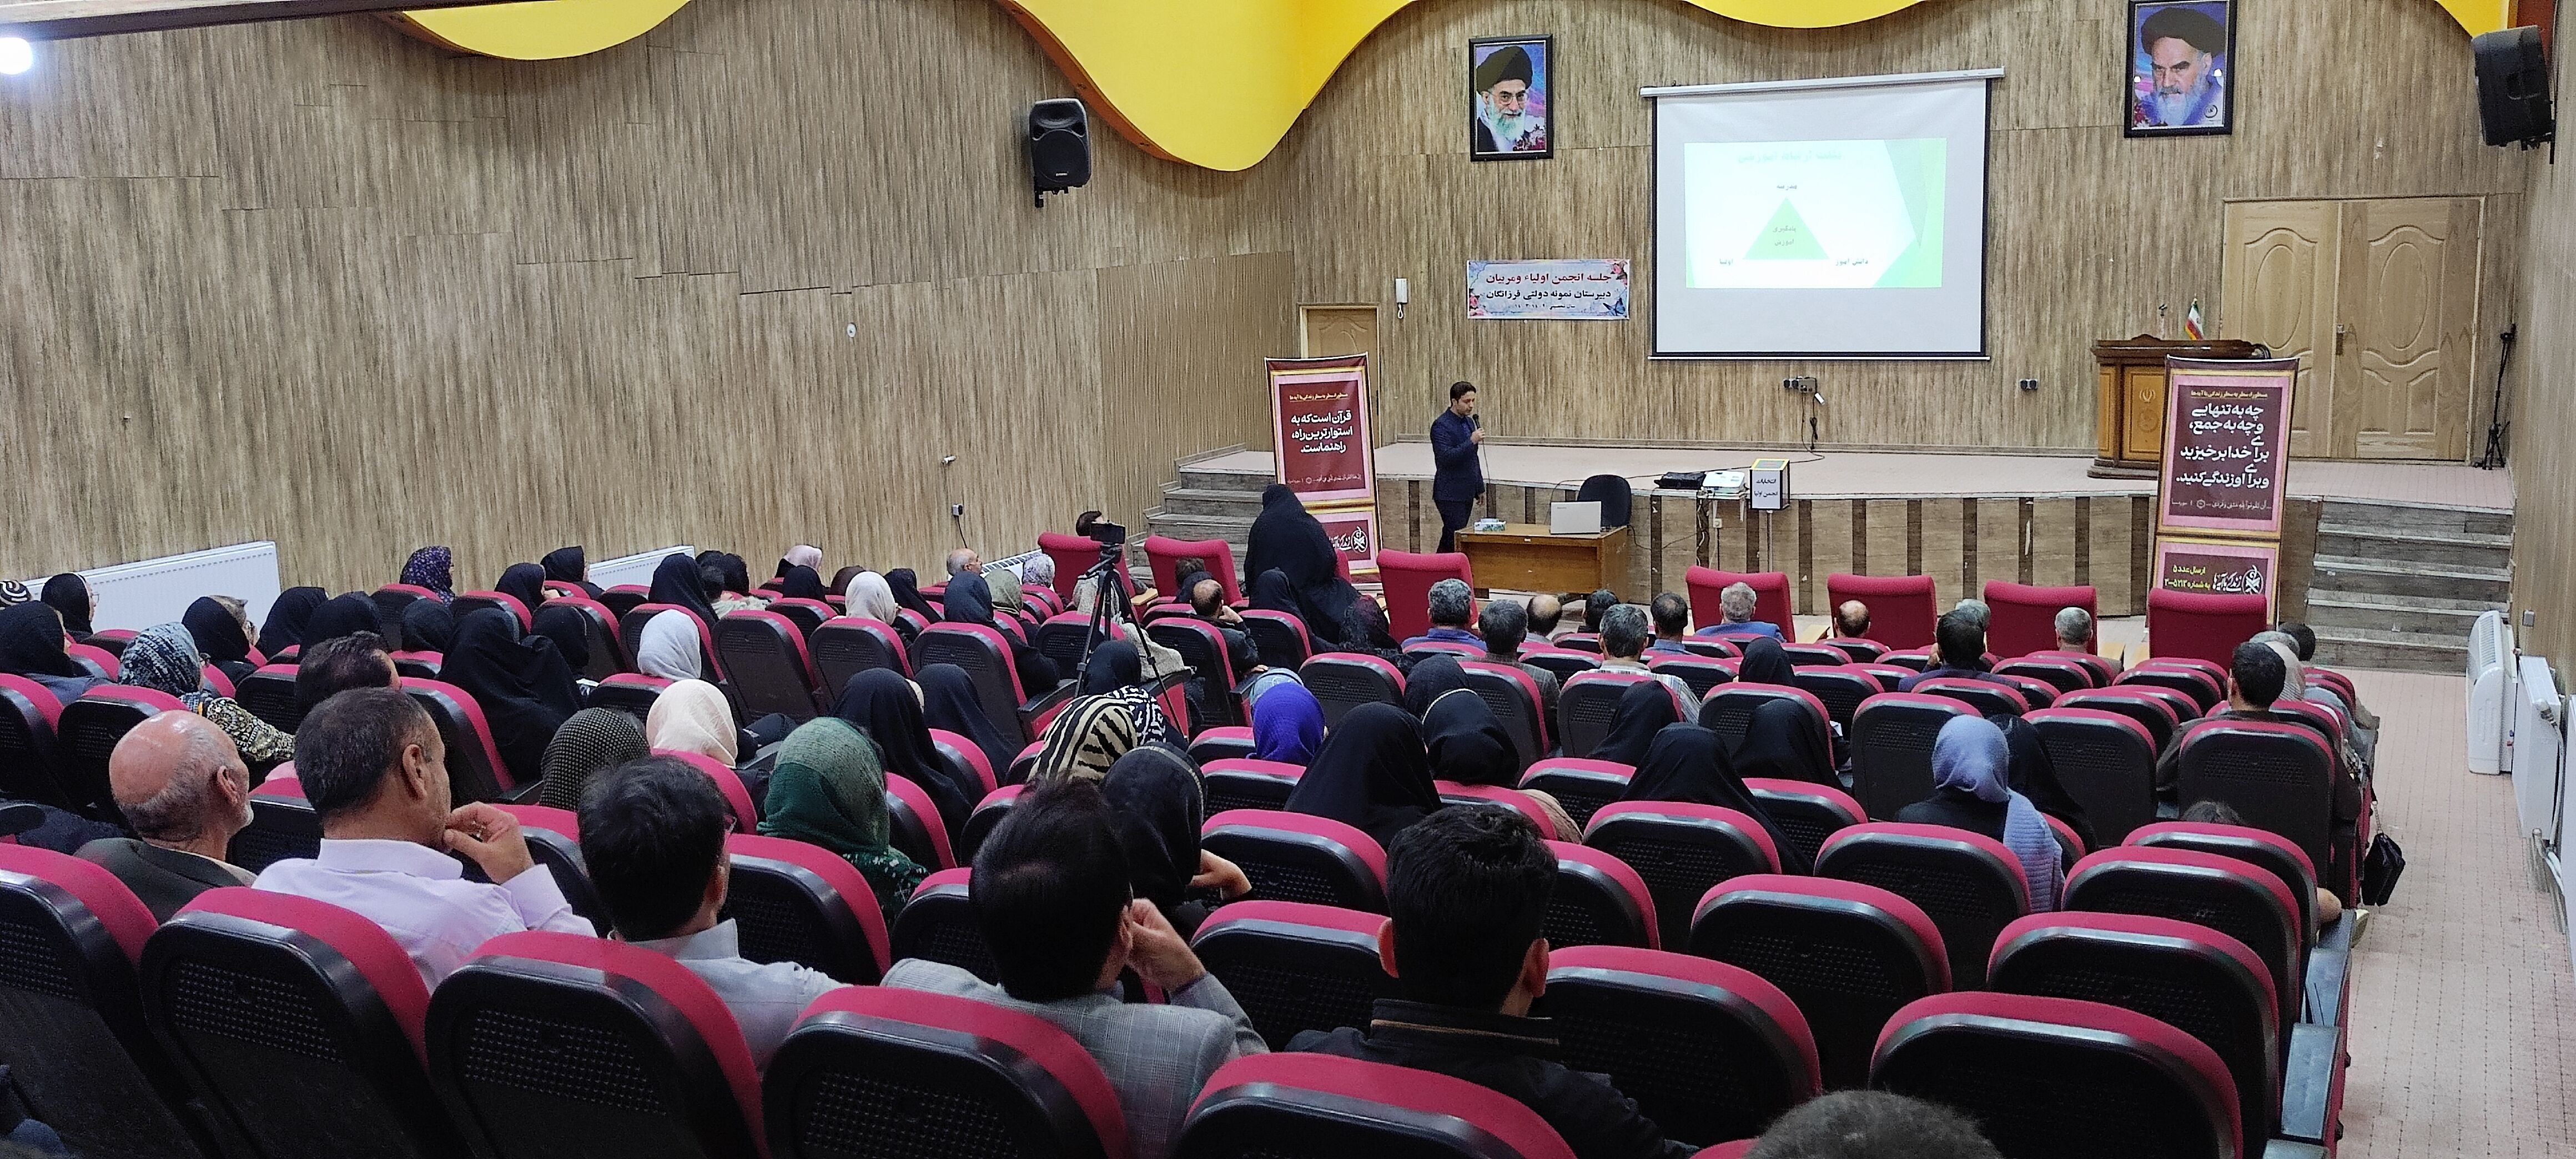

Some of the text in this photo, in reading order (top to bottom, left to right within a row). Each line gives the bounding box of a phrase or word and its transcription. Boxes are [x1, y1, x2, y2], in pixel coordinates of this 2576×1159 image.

[1524, 273, 1549, 284] اولیاء
[1552, 273, 1584, 285] انجمن
[1587, 273, 1612, 284] جلسه
[1486, 289, 1611, 300] دبیرستان نمونه دولتی فرزانگان
[1291, 409, 1352, 426] قرآن است که به
[2191, 402, 2264, 421] چه به تنهایی
[1305, 425, 1353, 441] استوارترین
[2223, 419, 2237, 434] به
[2180, 444, 2228, 462] برخیزید
[2228, 445, 2252, 459] خدا
[2202, 470, 2235, 488] زندگی
[2234, 473, 2246, 488] او
[2172, 564, 2178, 573] ۵
[2190, 566, 2206, 576] ارسال
[2187, 580, 2204, 589] شماره
[2205, 582, 2211, 591] به
